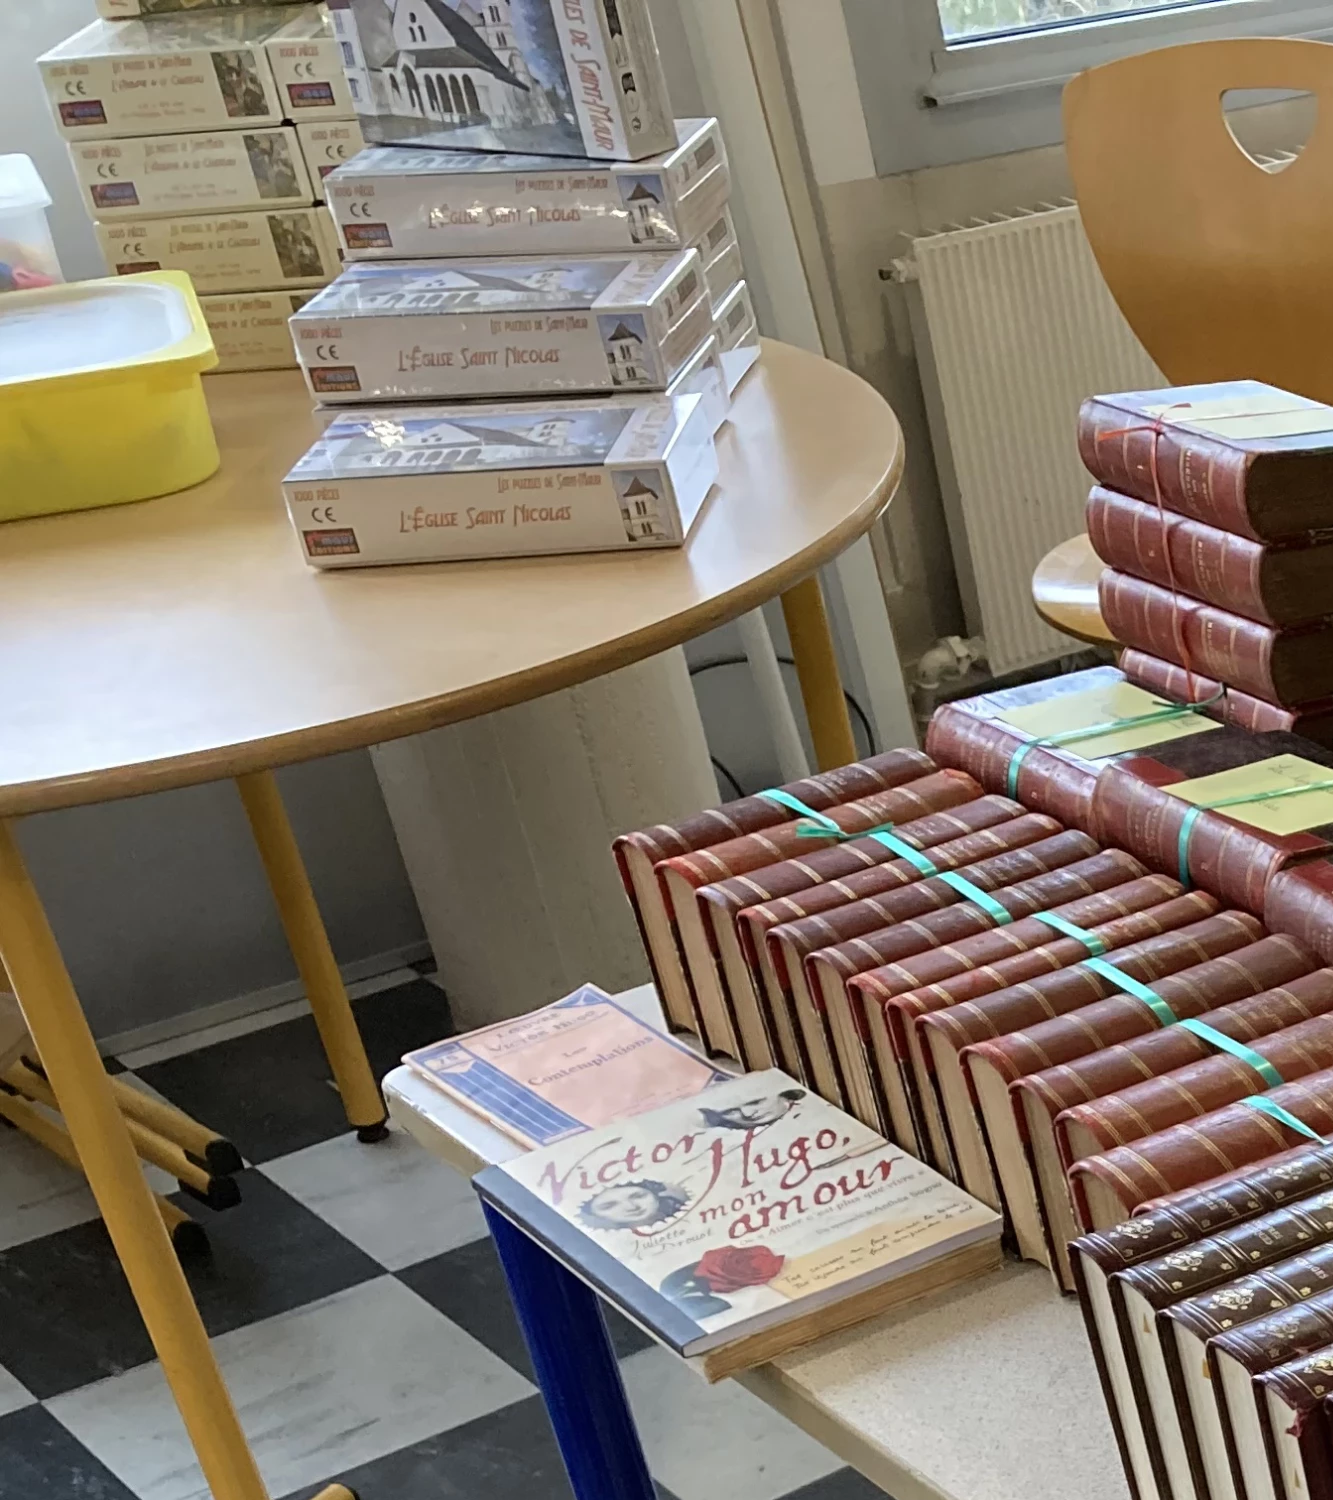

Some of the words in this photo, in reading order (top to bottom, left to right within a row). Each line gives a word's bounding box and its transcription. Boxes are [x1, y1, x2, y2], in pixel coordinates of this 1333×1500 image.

[570, 28, 591, 51] DE
[349, 202, 373, 218] CE
[316, 344, 340, 361] CE
[398, 345, 454, 373] L'ÉGLISE
[461, 348, 498, 370] SAINT
[505, 345, 560, 367] NICOLAS
[311, 507, 334, 523] CE
[400, 506, 459, 533] L'ÉGLISE
[466, 506, 505, 529] SAINT
[513, 504, 572, 527] NICOLAS
[526, 1034, 655, 1087] Contemplations
[536, 1131, 706, 1206] Victor
[698, 1188, 767, 1225] mon
[728, 1156, 905, 1240] amour
